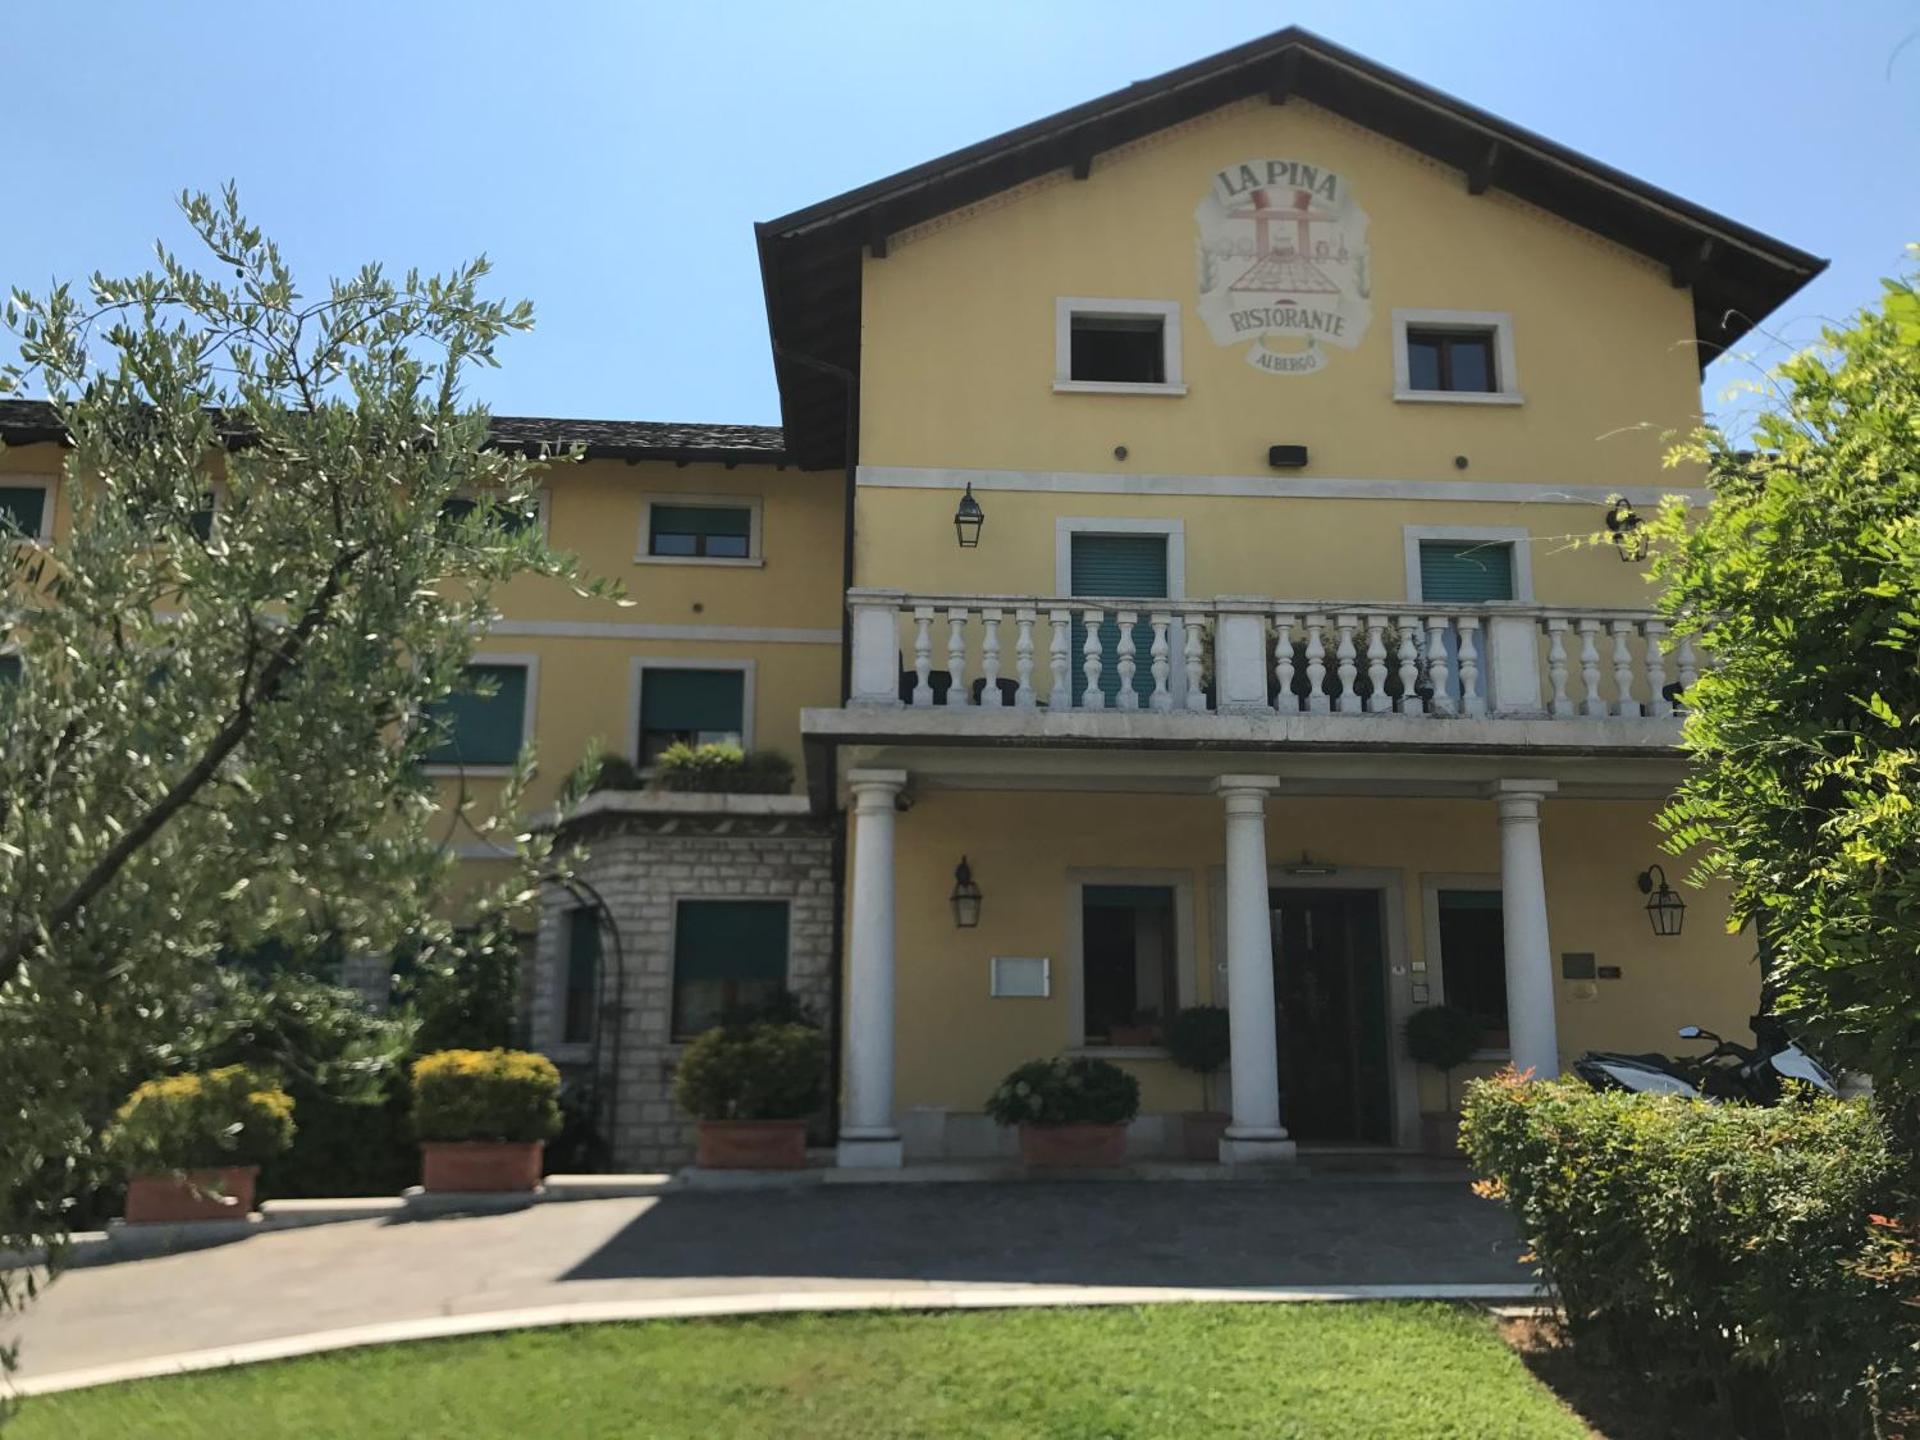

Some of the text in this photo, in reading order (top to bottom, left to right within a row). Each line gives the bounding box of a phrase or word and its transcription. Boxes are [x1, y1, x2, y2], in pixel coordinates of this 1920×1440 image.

[1218, 161, 1338, 201] LA PINA
[1230, 308, 1346, 336] RISTORANTE
[1256, 353, 1316, 372] ALBERGO
